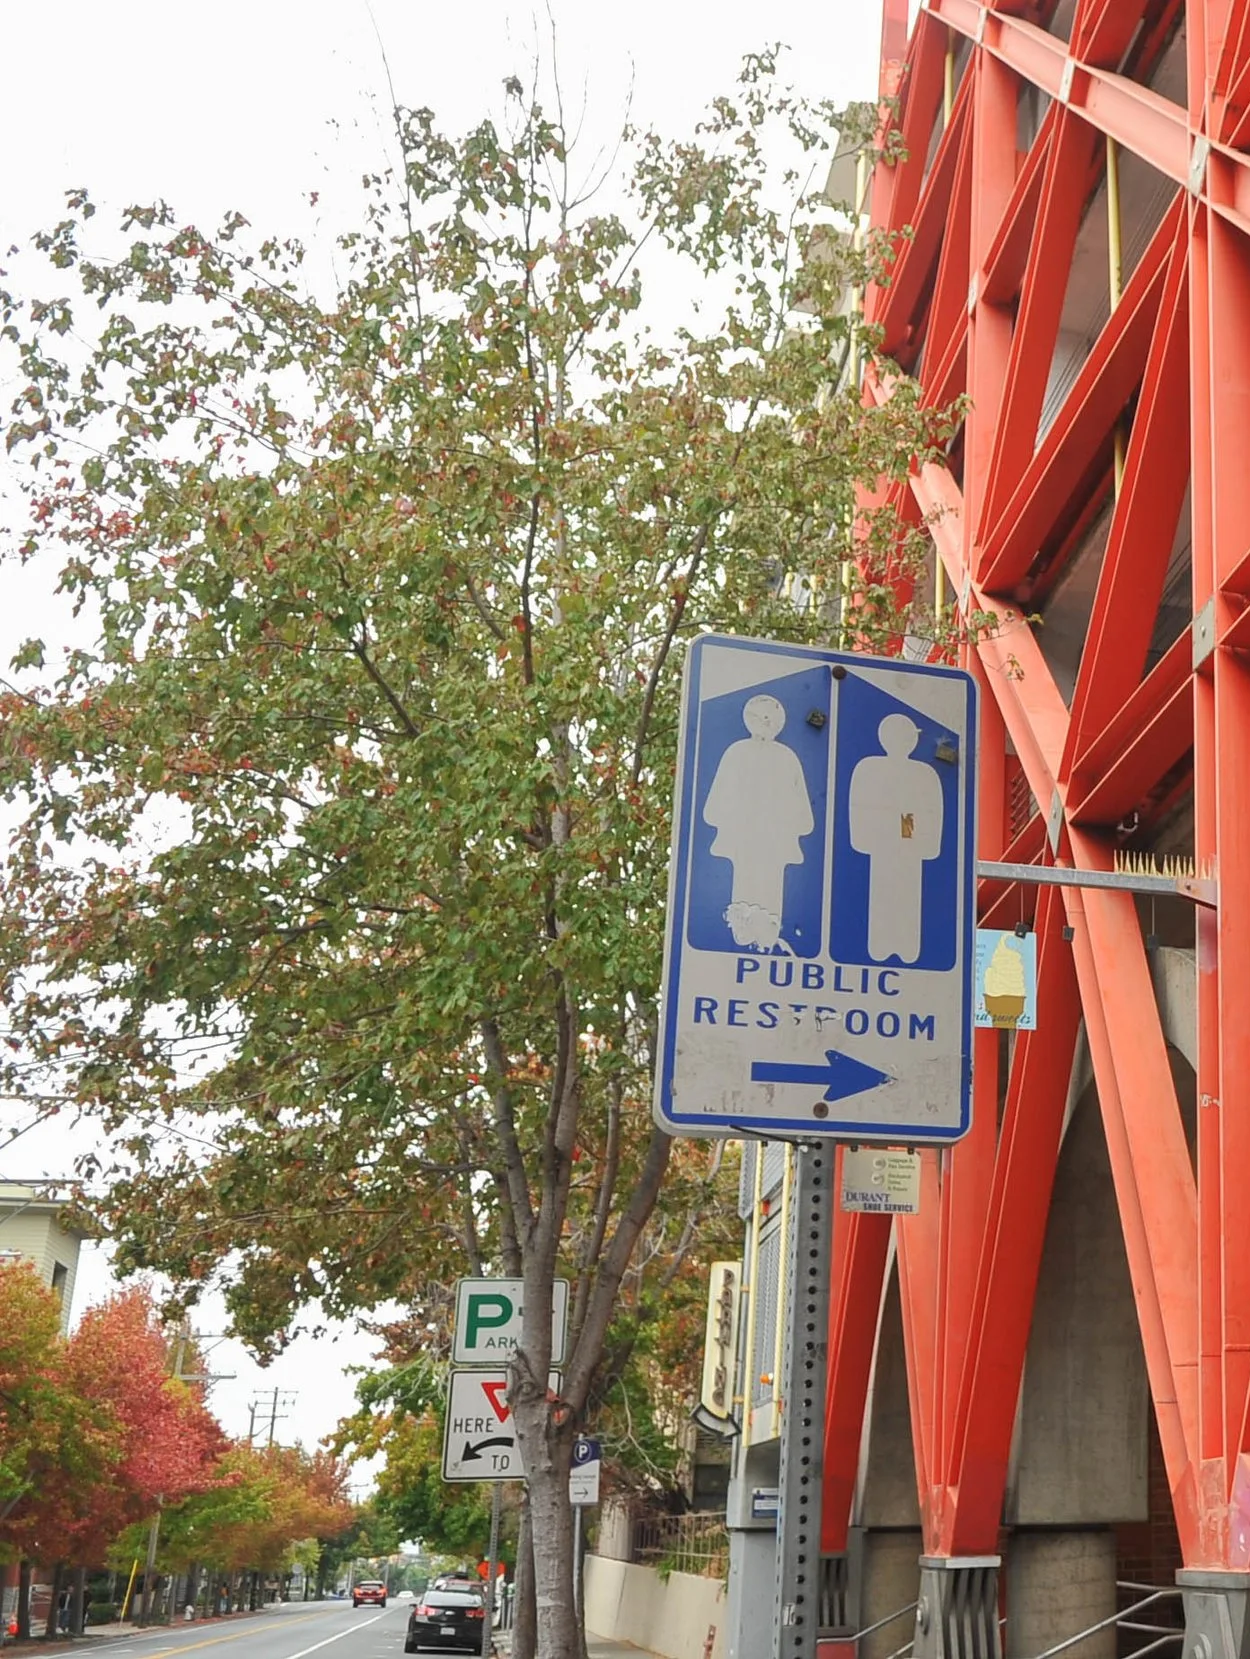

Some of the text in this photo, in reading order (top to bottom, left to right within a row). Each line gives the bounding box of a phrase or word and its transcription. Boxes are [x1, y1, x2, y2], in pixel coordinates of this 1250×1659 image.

[736, 957, 900, 996] PUBLIC
[846, 1191, 891, 1202] DURANT
[863, 1203, 913, 1212] SHOE SERVICE
[453, 1417, 494, 1433] HERE
[491, 1455, 510, 1470] TO
